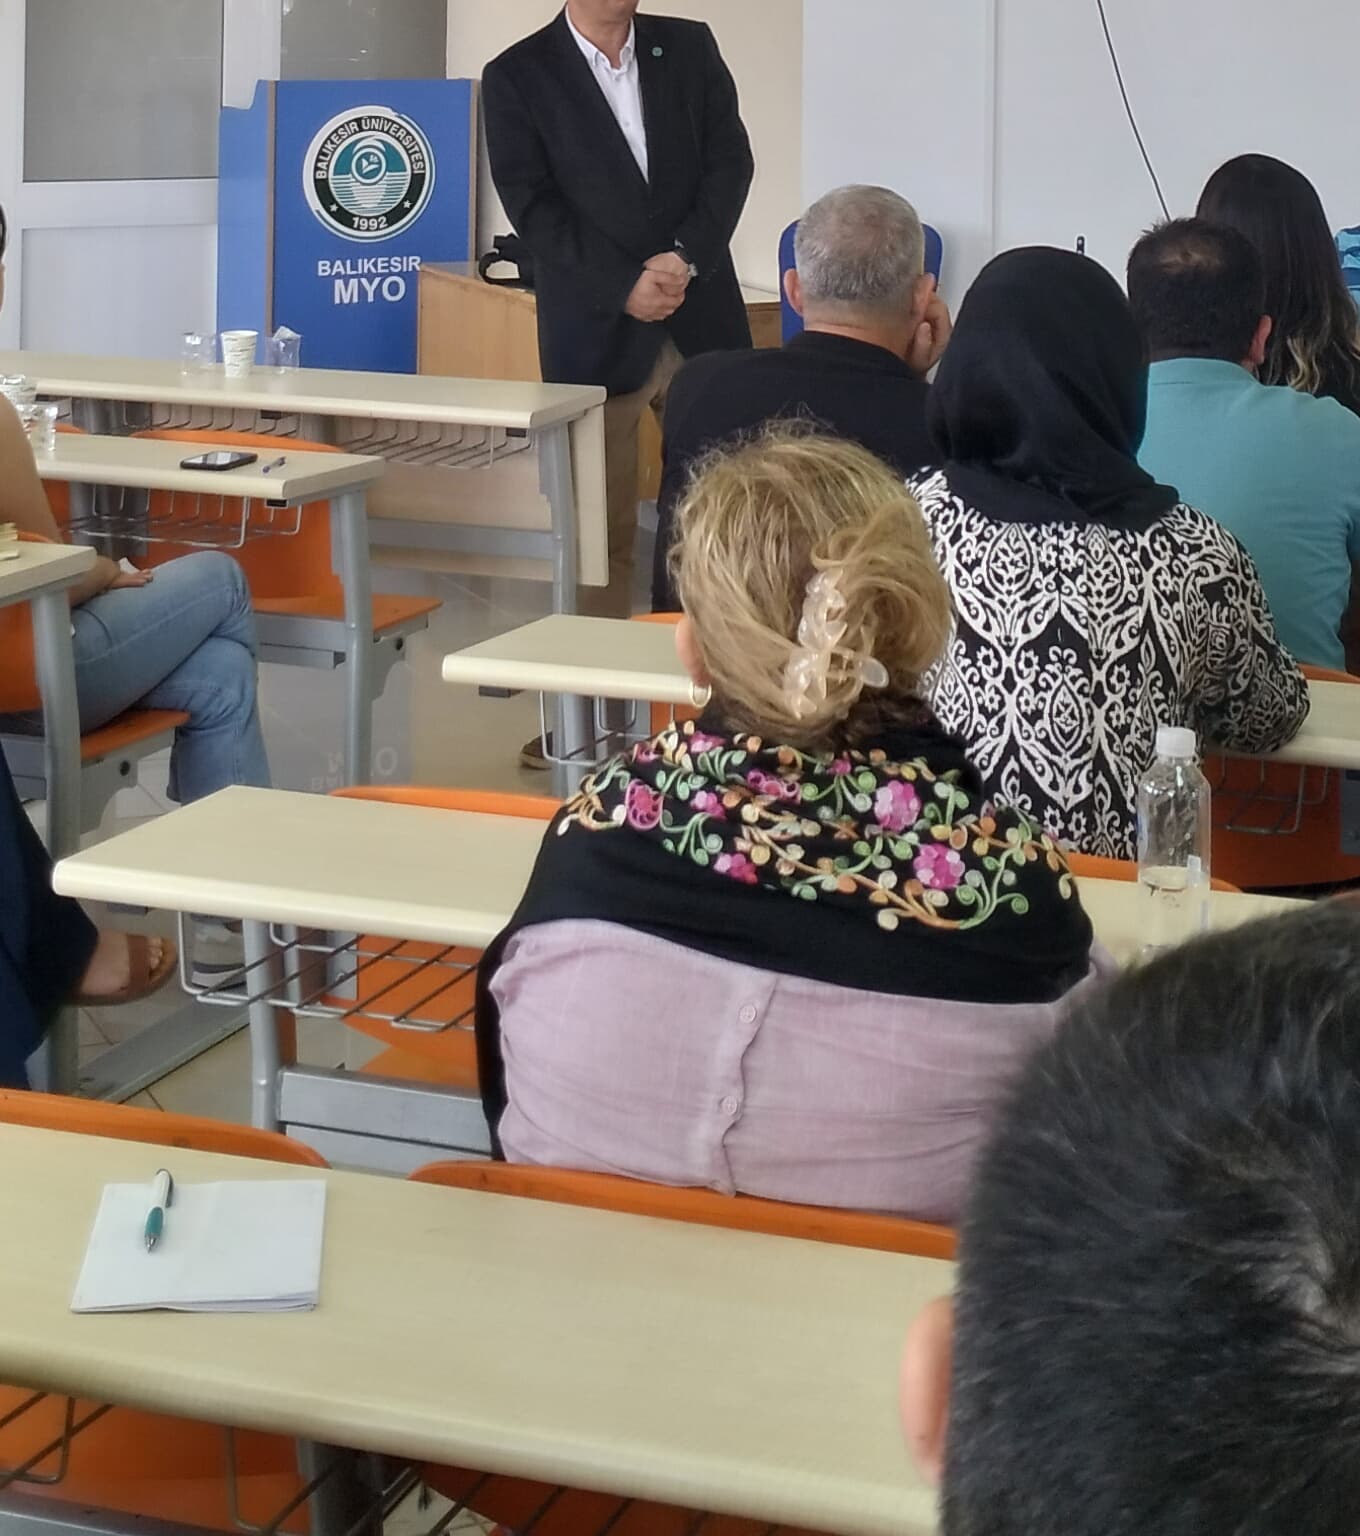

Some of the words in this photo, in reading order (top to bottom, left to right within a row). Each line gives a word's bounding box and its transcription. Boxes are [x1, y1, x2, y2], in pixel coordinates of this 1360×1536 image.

[352, 216, 388, 230] 1992
[317, 255, 421, 277] BALIKESIR
[334, 275, 406, 305] MYO
